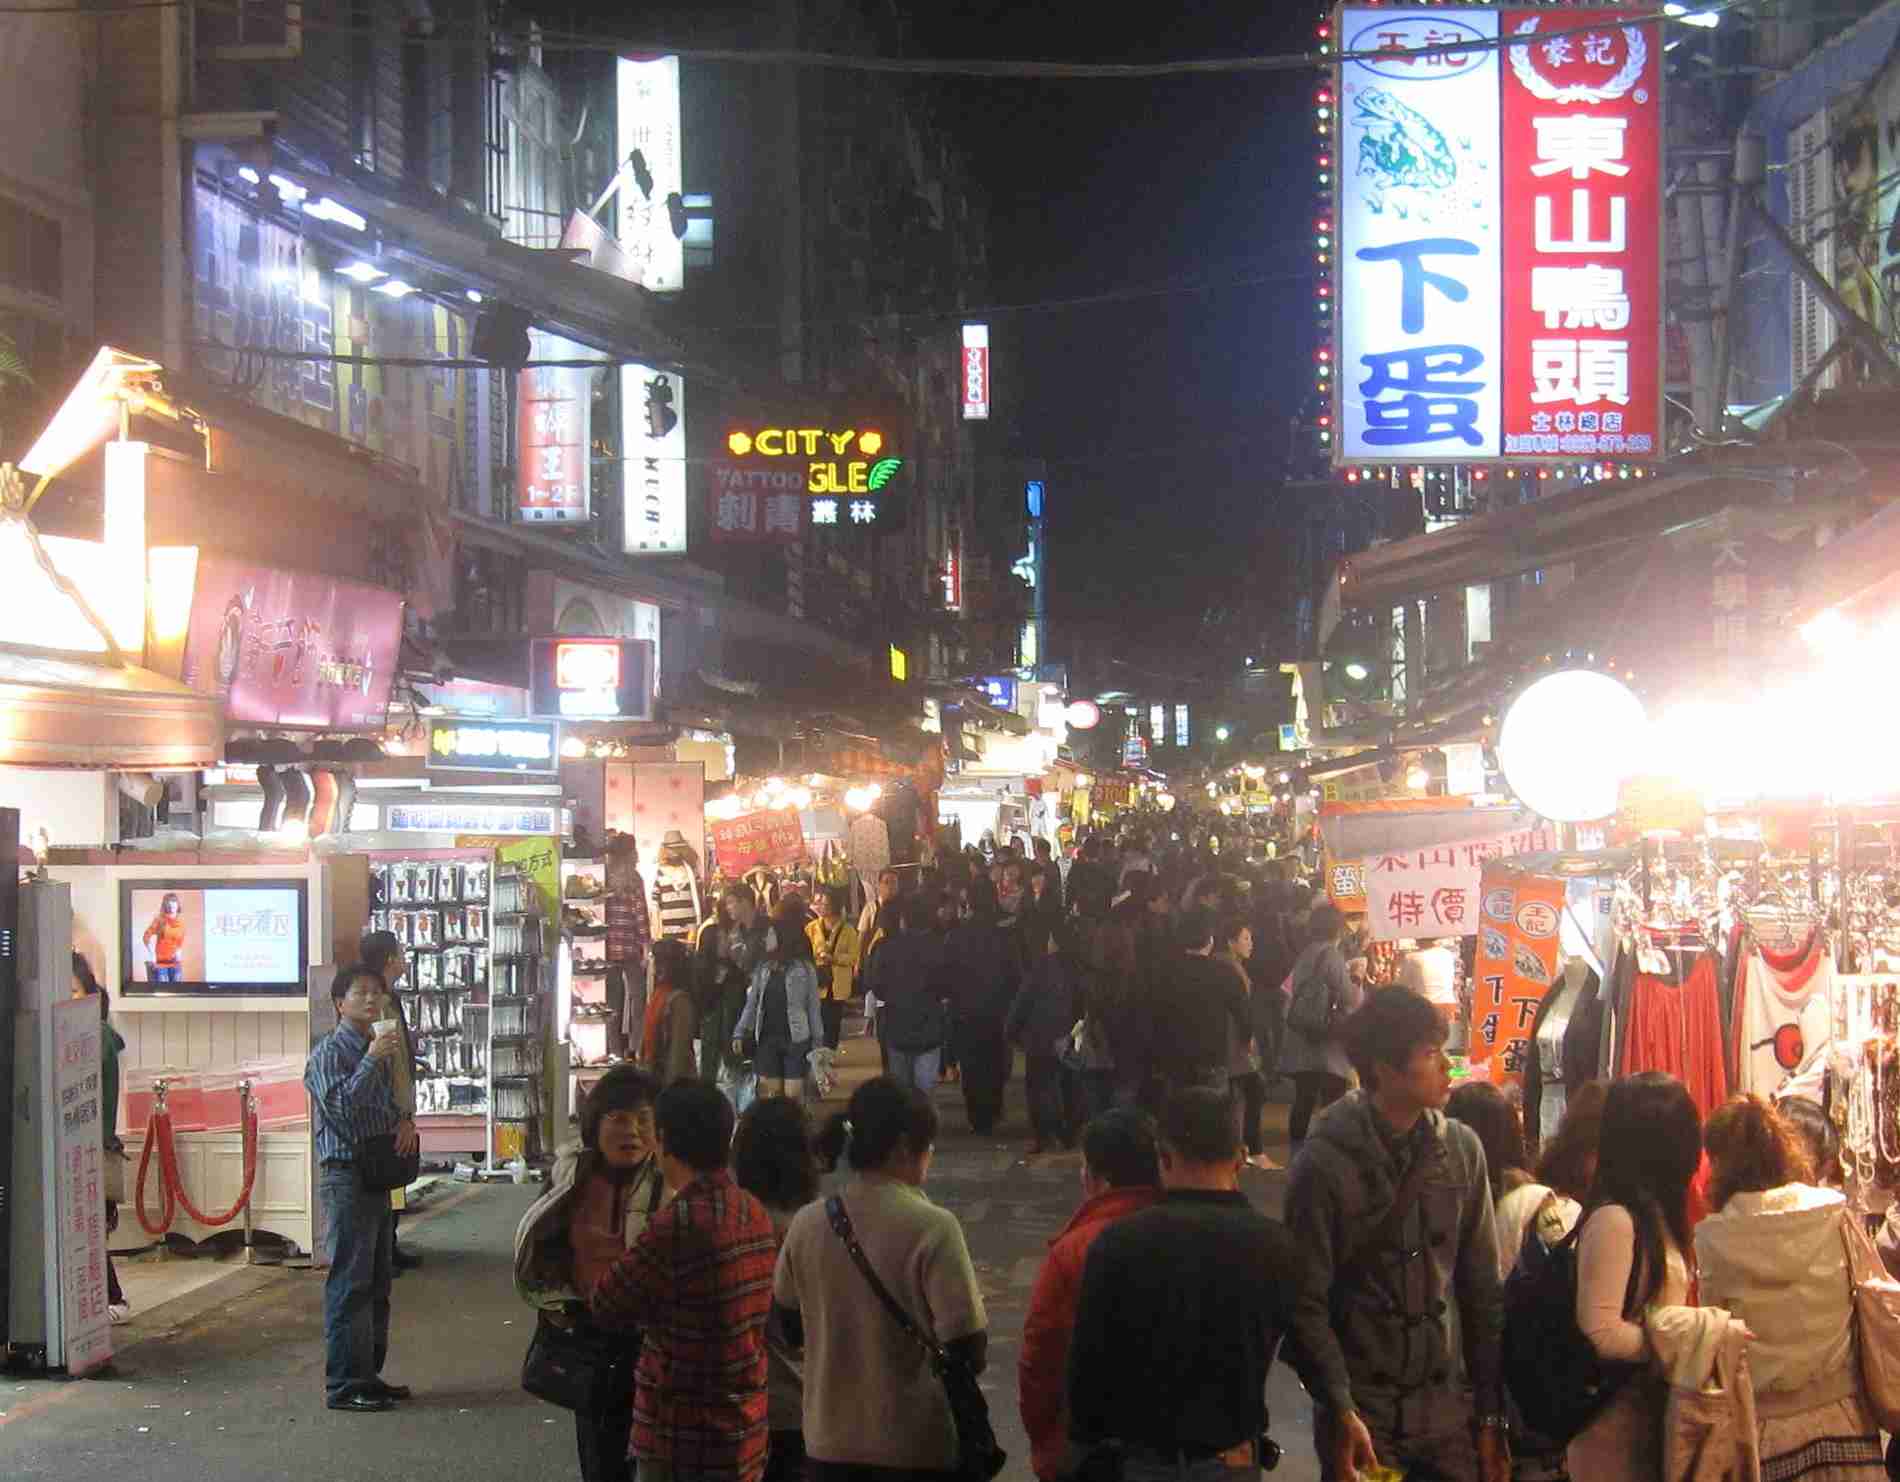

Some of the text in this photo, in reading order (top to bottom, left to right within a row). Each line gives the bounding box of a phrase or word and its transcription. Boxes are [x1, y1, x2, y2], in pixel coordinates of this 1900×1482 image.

[1529, 113, 1630, 405] 東山鴨頭
[1355, 237, 1486, 446] 下蛋
[755, 430, 855, 455] CITY
[1388, 887, 1466, 929] 特價
